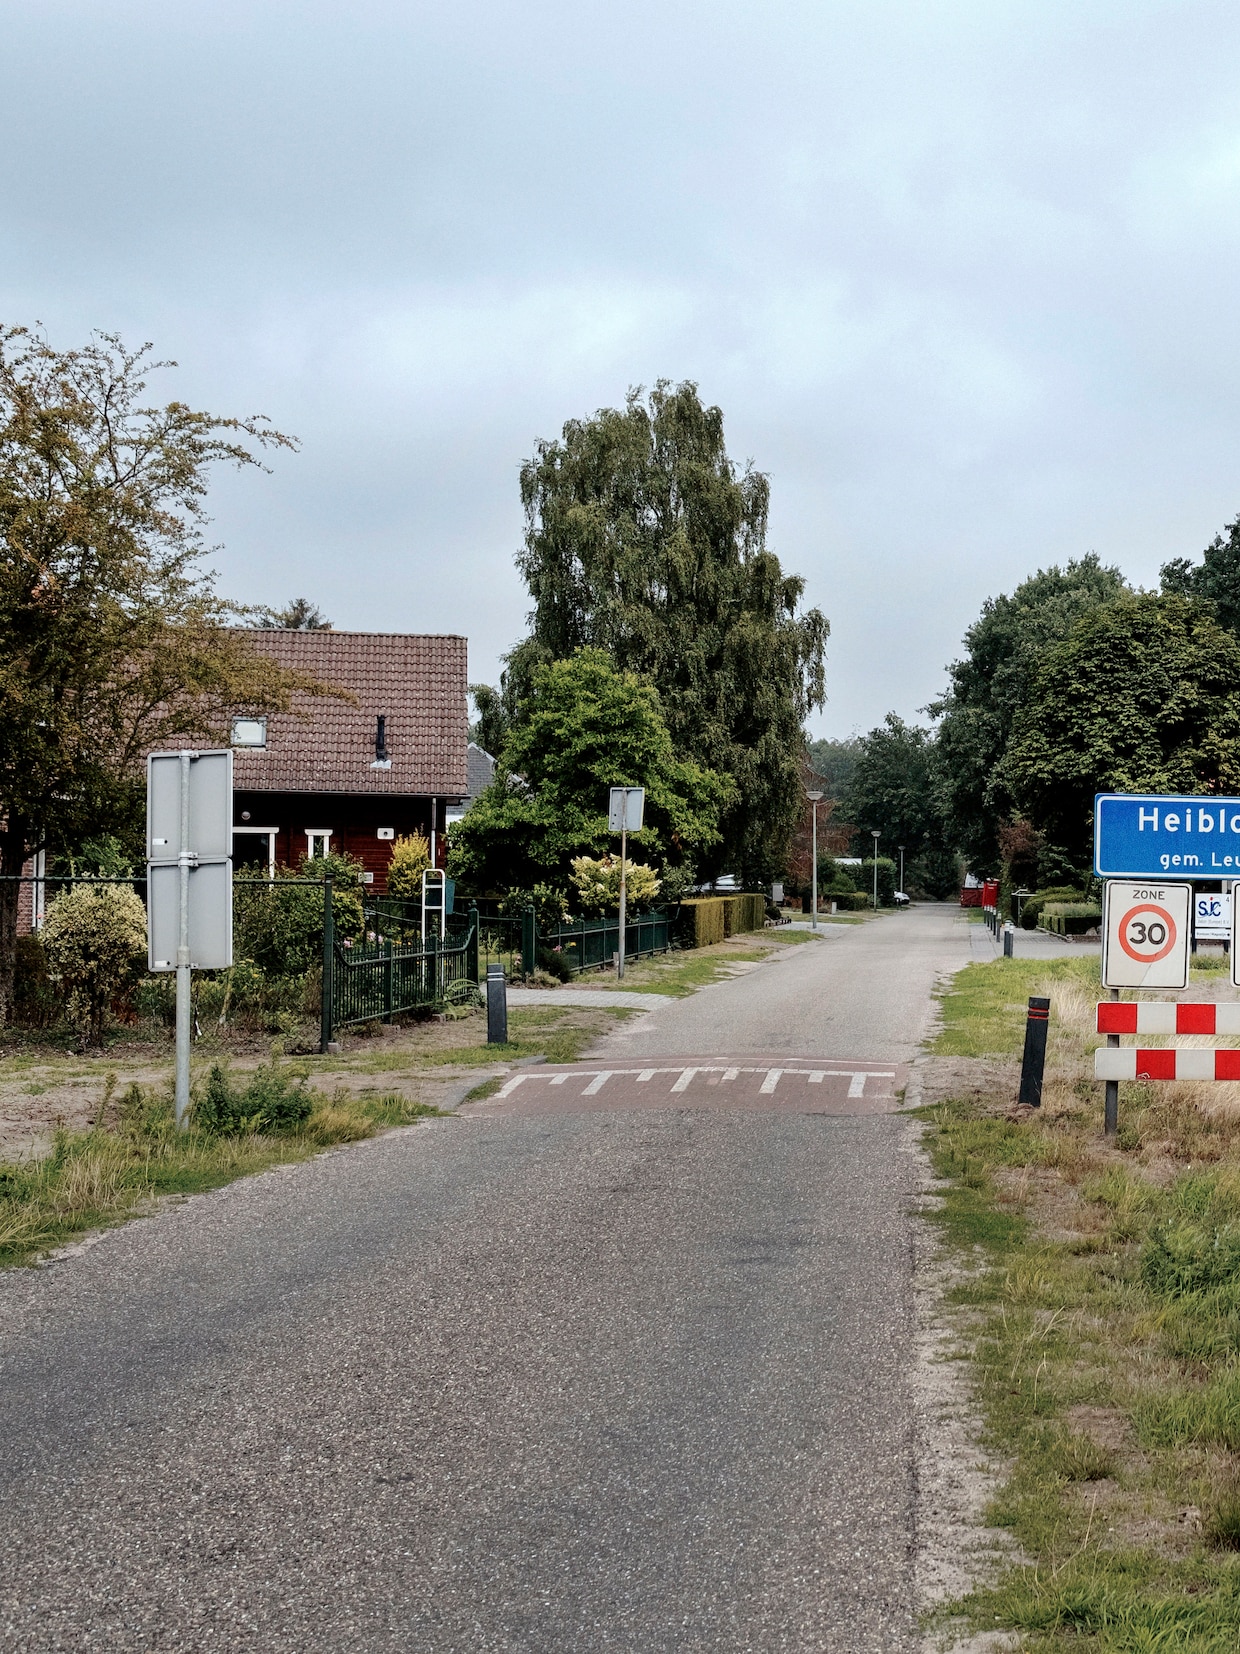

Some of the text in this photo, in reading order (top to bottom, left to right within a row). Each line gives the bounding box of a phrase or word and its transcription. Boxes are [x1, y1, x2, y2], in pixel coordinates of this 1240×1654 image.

[1159, 853, 1204, 871] gem.
[1132, 889, 1166, 901] ZONE
[1129, 921, 1166, 946] 30
